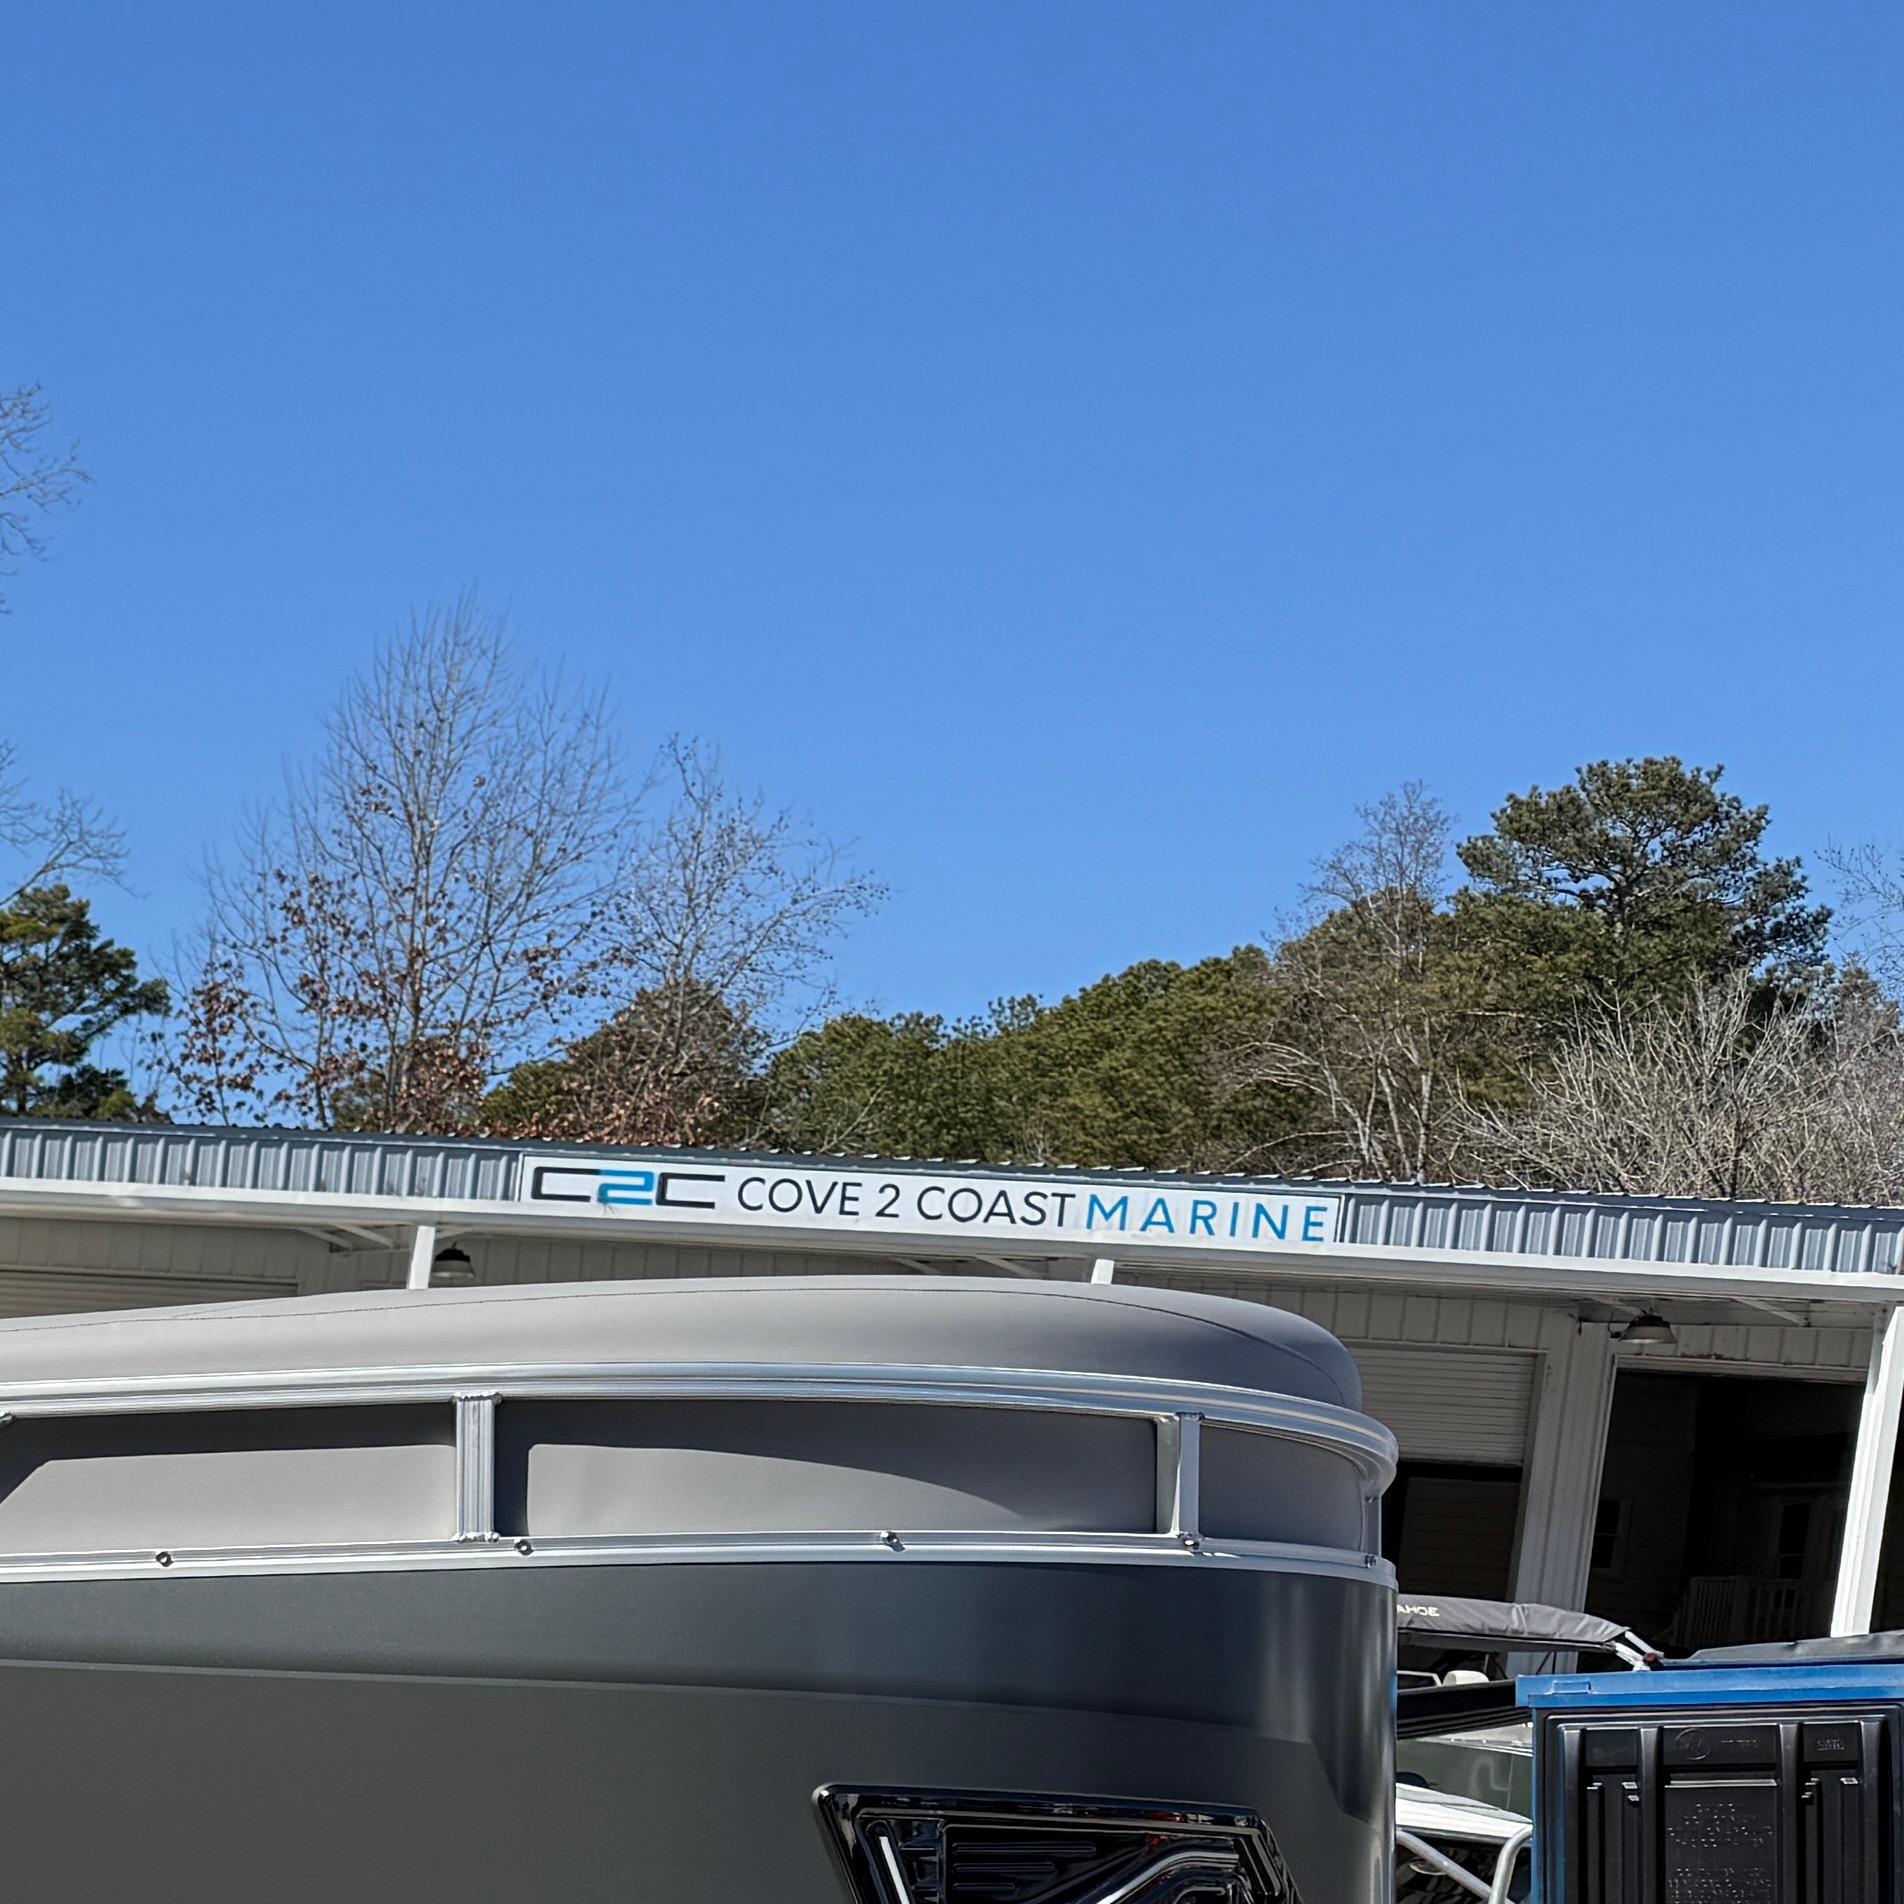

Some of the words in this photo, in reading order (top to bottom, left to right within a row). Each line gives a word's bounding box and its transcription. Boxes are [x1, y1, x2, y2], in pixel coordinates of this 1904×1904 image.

[530, 1166, 727, 1209] C2C
[737, 1176, 863, 1216] COVE
[875, 1183, 901, 1219] 2
[916, 1185, 1076, 1227] COAST
[1085, 1193, 1329, 1242] MARINE
[1396, 1603, 1440, 1617] AHOE
